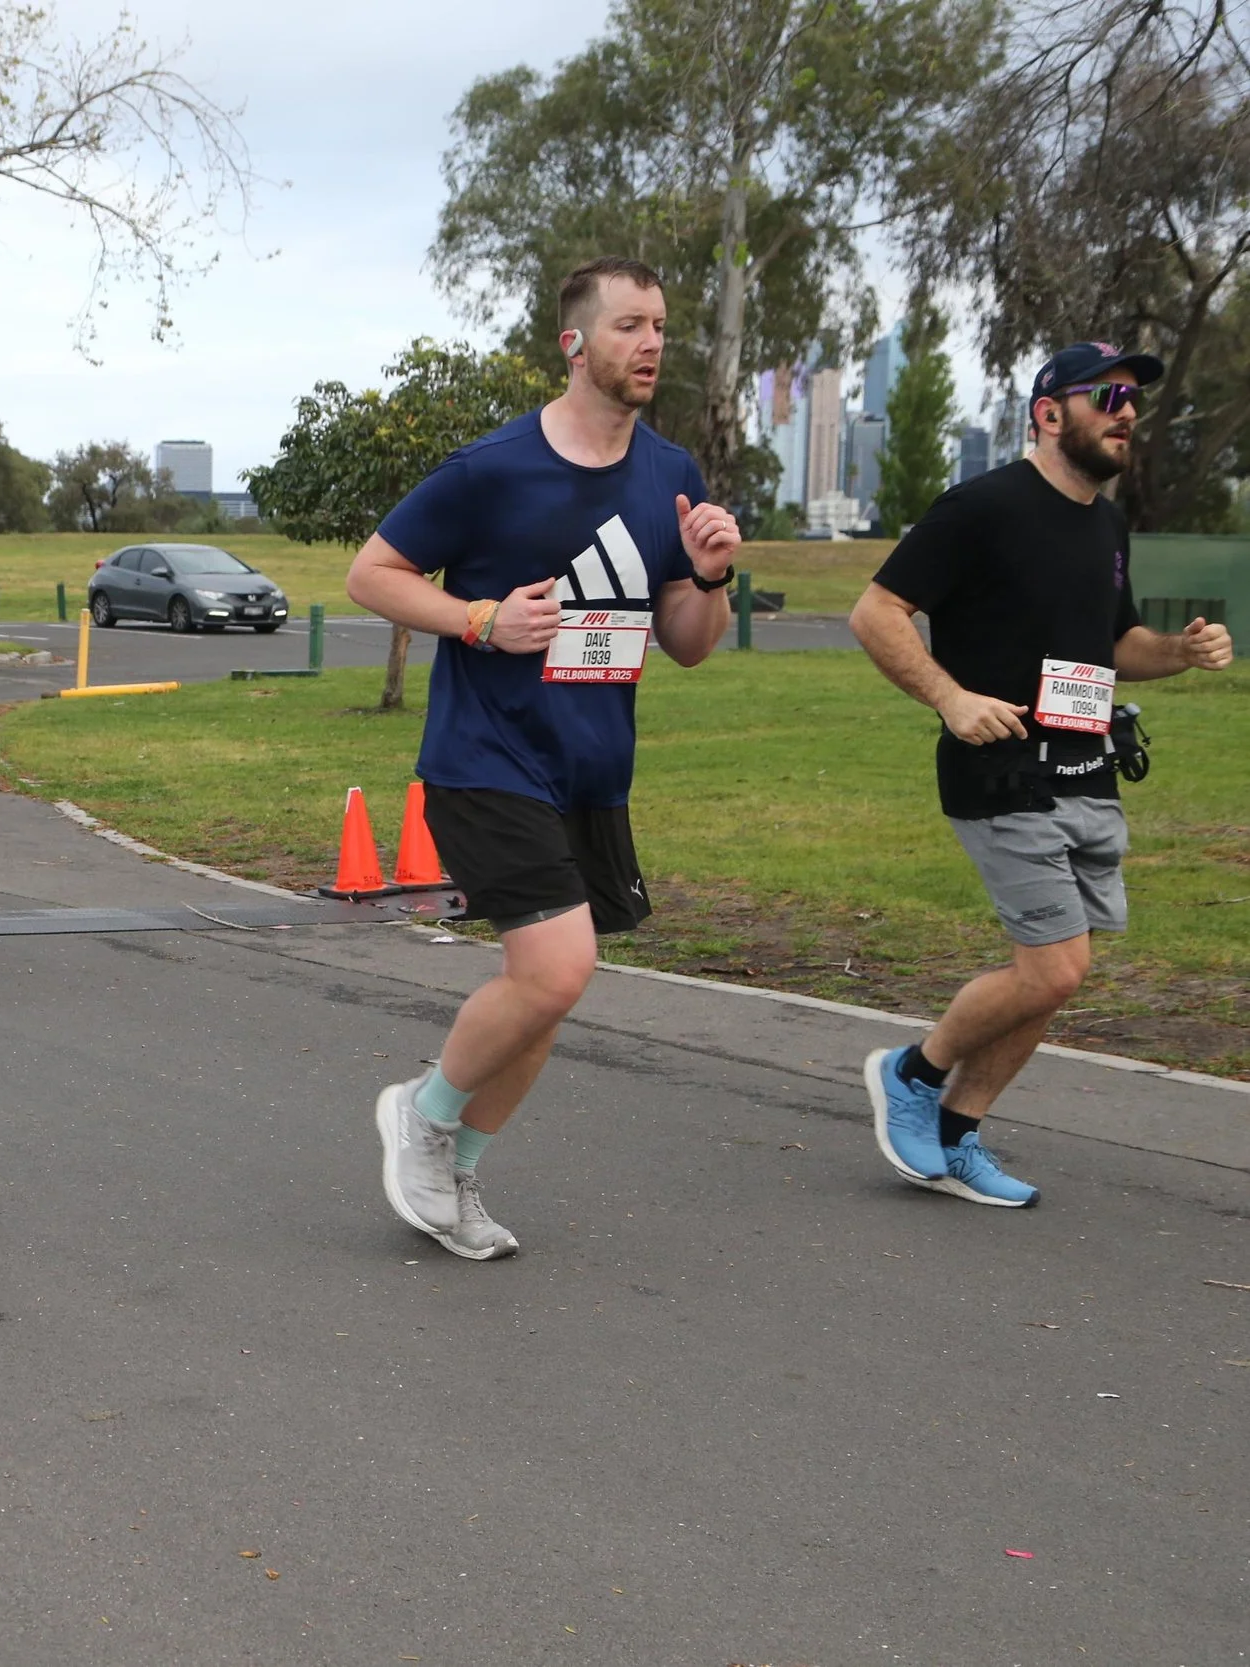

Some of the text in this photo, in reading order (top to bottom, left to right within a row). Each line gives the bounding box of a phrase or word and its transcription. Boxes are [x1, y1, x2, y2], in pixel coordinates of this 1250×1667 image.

[585, 632, 612, 648] DAVE
[582, 650, 612, 665] 11939
[552, 669, 633, 680] MELBOURNE 2025
[1051, 681, 1093, 699] RAMMBO
[1071, 700, 1098, 715] 10994
[1044, 714, 1095, 728] MELBOURNE
[1056, 756, 1104, 775] nerd belt
